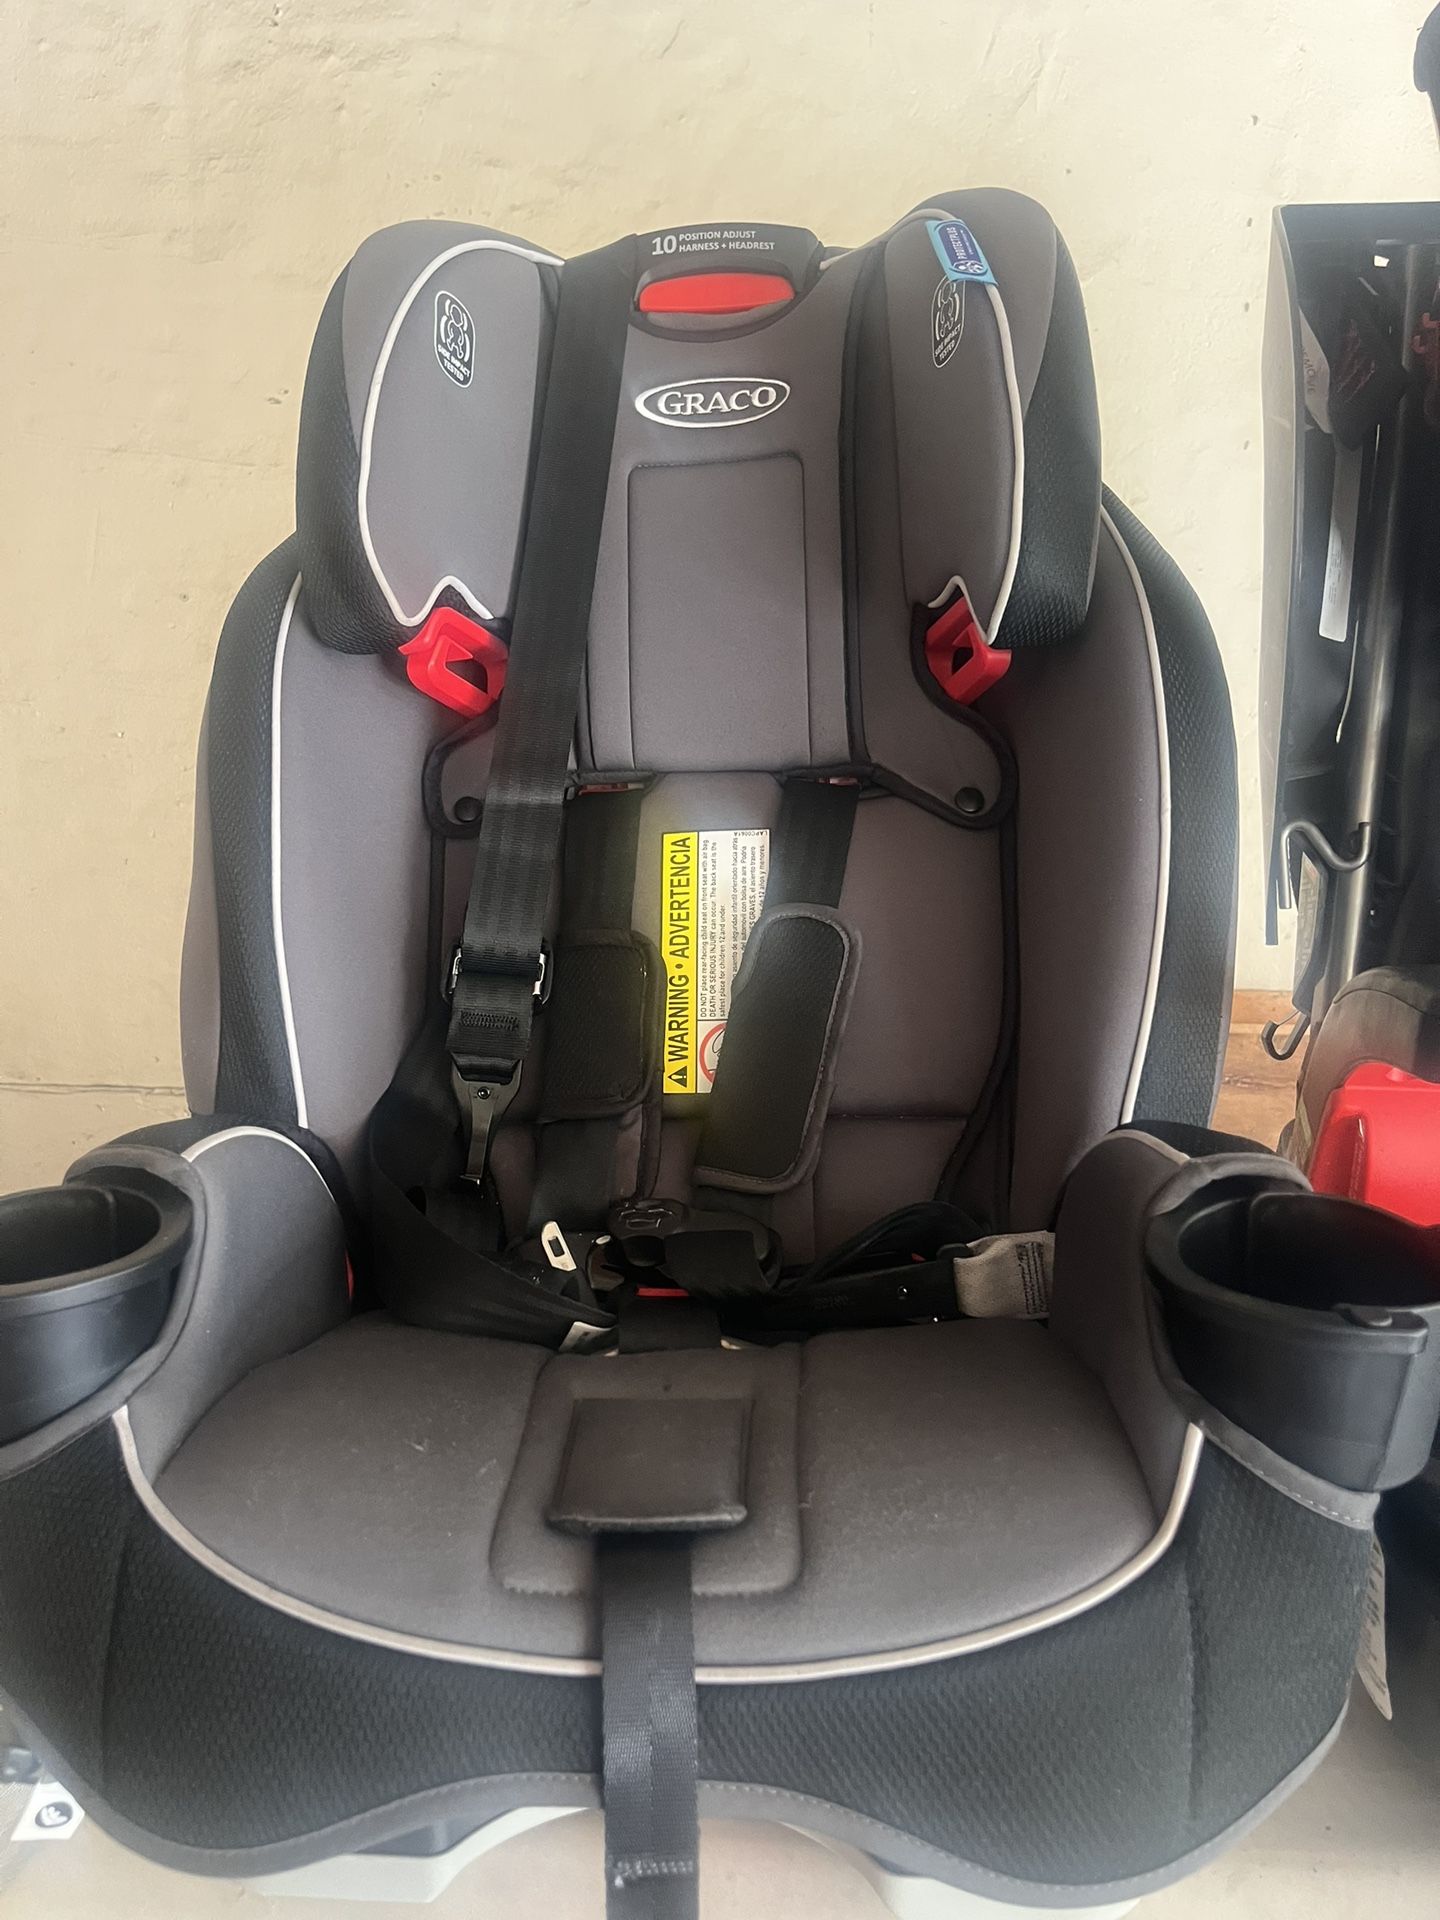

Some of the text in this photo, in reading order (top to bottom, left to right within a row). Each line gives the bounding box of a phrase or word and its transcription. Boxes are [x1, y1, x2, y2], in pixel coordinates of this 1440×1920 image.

[652, 230, 756, 255] 10 POSITION ADJUST
[679, 242, 719, 253] HARNESS
[728, 241, 775, 250] HEADREST
[939, 340, 955, 360] TESTED
[443, 358, 464, 381] TESTED
[657, 386, 777, 415] GRACO
[668, 837, 690, 1062] WARNING ADVERTENCIA
[710, 985, 716, 994] OR
[701, 1008, 706, 1017] DO
